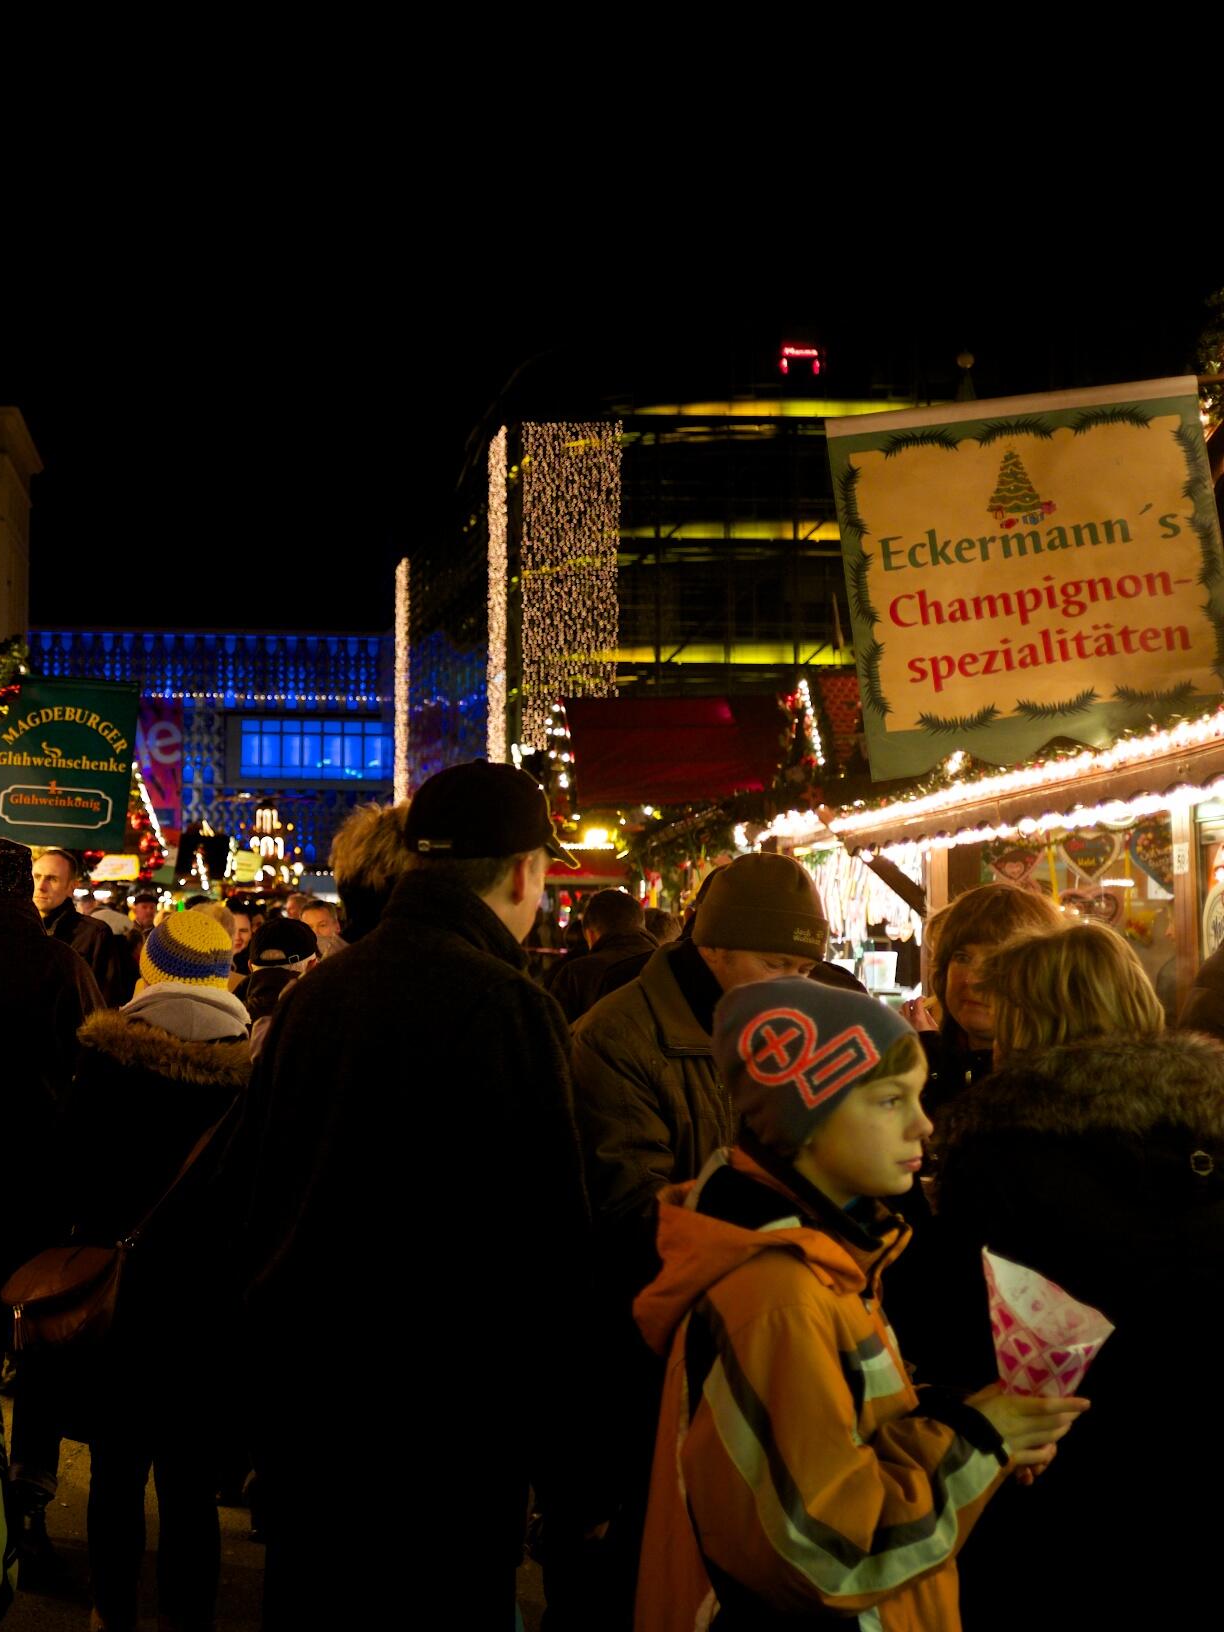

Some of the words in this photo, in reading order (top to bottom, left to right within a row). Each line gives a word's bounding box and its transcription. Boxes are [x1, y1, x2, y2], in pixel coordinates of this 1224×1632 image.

[888, 568, 1193, 630] Champignon-
[907, 623, 1192, 693] spezialitäten
[2, 706, 129, 754] MAGDEBURGER
